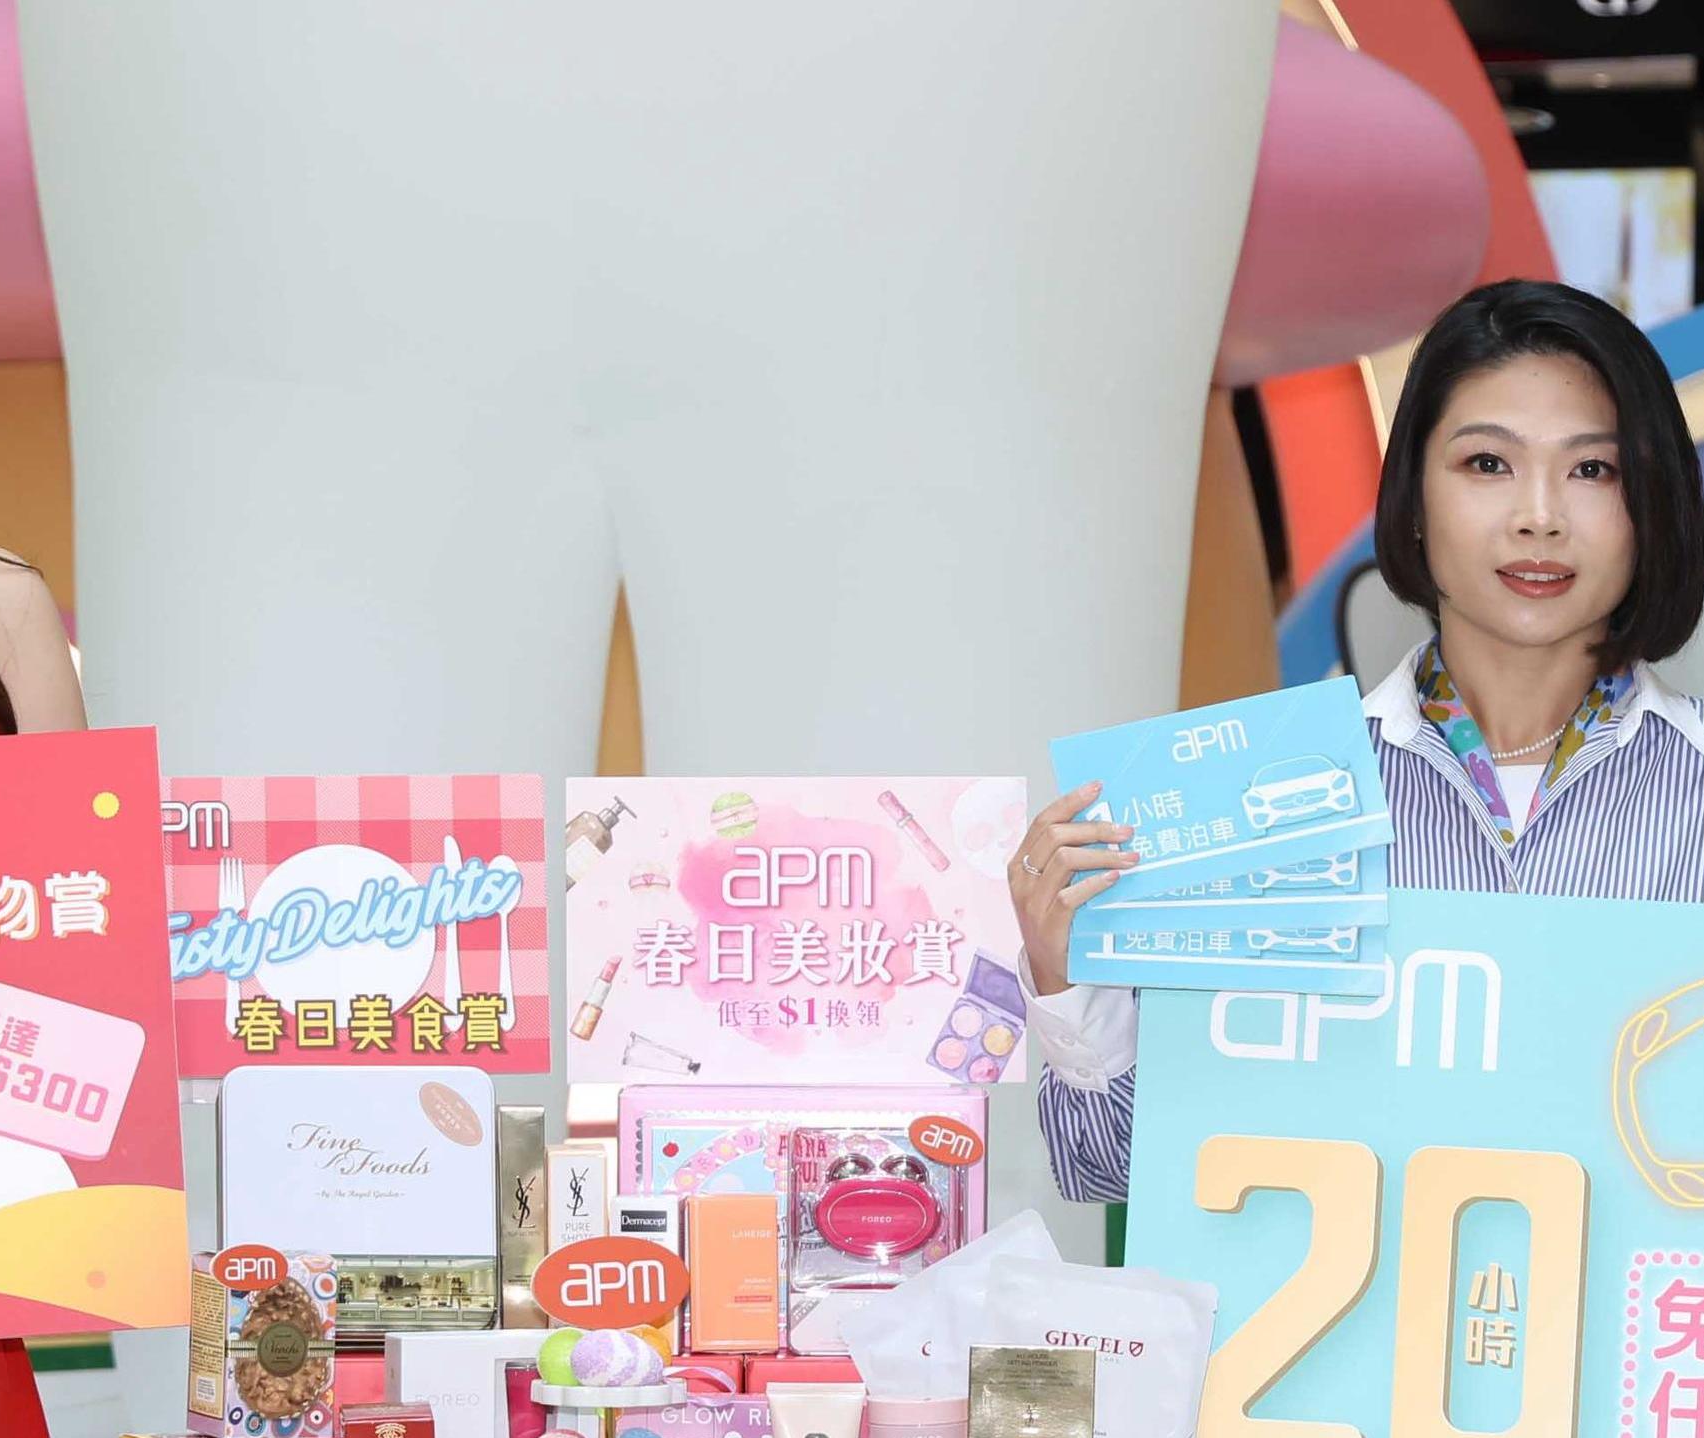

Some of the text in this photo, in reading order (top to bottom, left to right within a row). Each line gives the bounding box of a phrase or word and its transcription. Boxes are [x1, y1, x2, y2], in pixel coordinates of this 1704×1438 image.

[1123, 788, 1185, 828] 小時
[1128, 816, 1239, 859] 免費泊車
[266, 856, 524, 963] Delights
[633, 919, 963, 985] 春日美妝賞
[235, 991, 508, 1053] 春日美食賞
[287, 1122, 362, 1152] Fine
[317, 1147, 432, 1176] Foods
[565, 1222, 592, 1232] PURE
[621, 1214, 668, 1229] Dermacept
[861, 1215, 892, 1224] FOREO
[1464, 1262, 1519, 1370] 小時
[661, 1408, 736, 1425] GLOW
